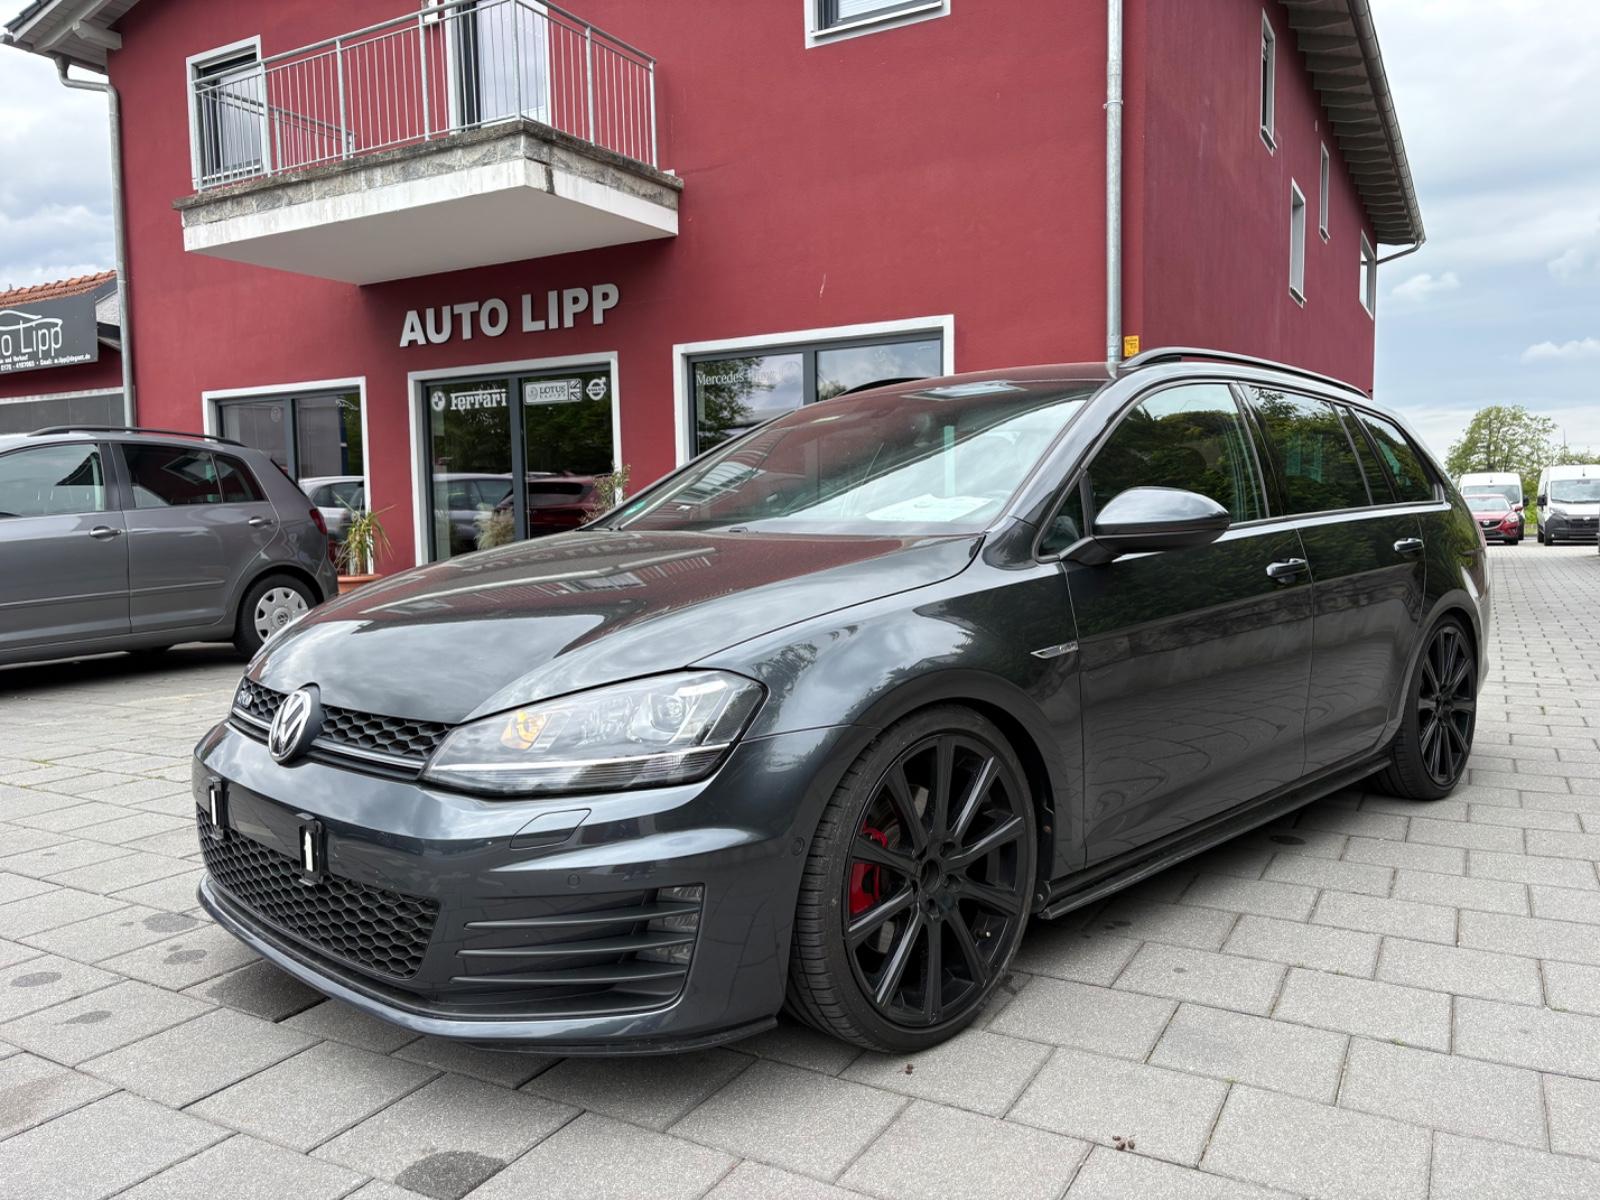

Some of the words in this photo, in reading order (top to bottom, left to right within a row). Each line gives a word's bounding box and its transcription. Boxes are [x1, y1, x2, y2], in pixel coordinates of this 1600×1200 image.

[399, 298, 509, 348] AUTO
[521, 283, 620, 333] LIPP
[20, 320, 63, 358] Lipp
[450, 389, 507, 414] Ferrari
[540, 384, 566, 395] LOTUS
